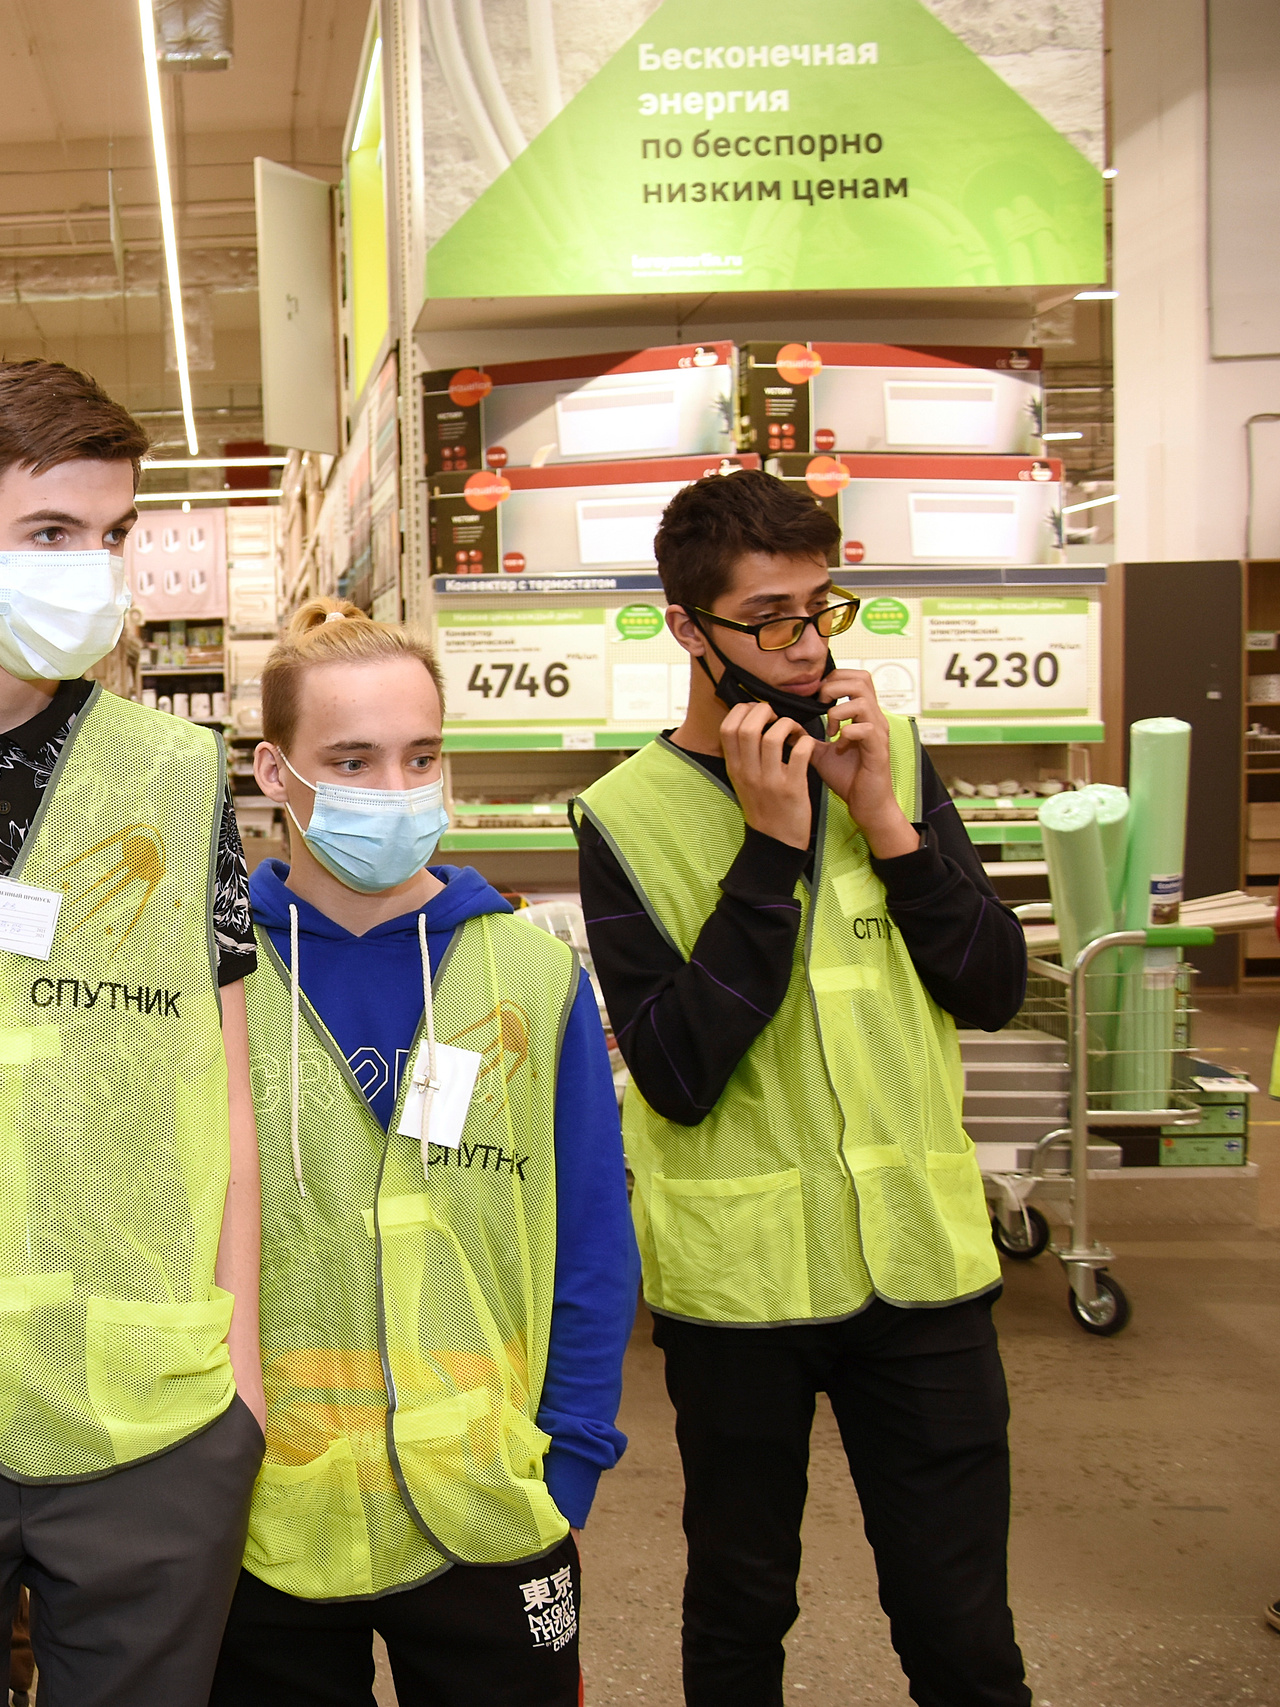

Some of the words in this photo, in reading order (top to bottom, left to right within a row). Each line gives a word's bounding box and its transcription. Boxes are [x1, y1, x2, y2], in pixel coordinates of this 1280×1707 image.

[638, 42, 879, 71] Бесконечная
[638, 89, 789, 121] энергия
[641, 137, 683, 160] по
[693, 129, 883, 162] бесспорно
[643, 179, 781, 204] низким
[793, 177, 908, 206] ценам
[445, 579, 517, 592] Конвектор
[528, 579, 617, 591] термостатом
[467, 662, 570, 698] 4746
[945, 651, 1059, 688] 4230
[23, 894, 51, 904] ПРОПУСК
[31, 977, 182, 1019] СПУТНИК
[519, 1564, 573, 1612] 東京
